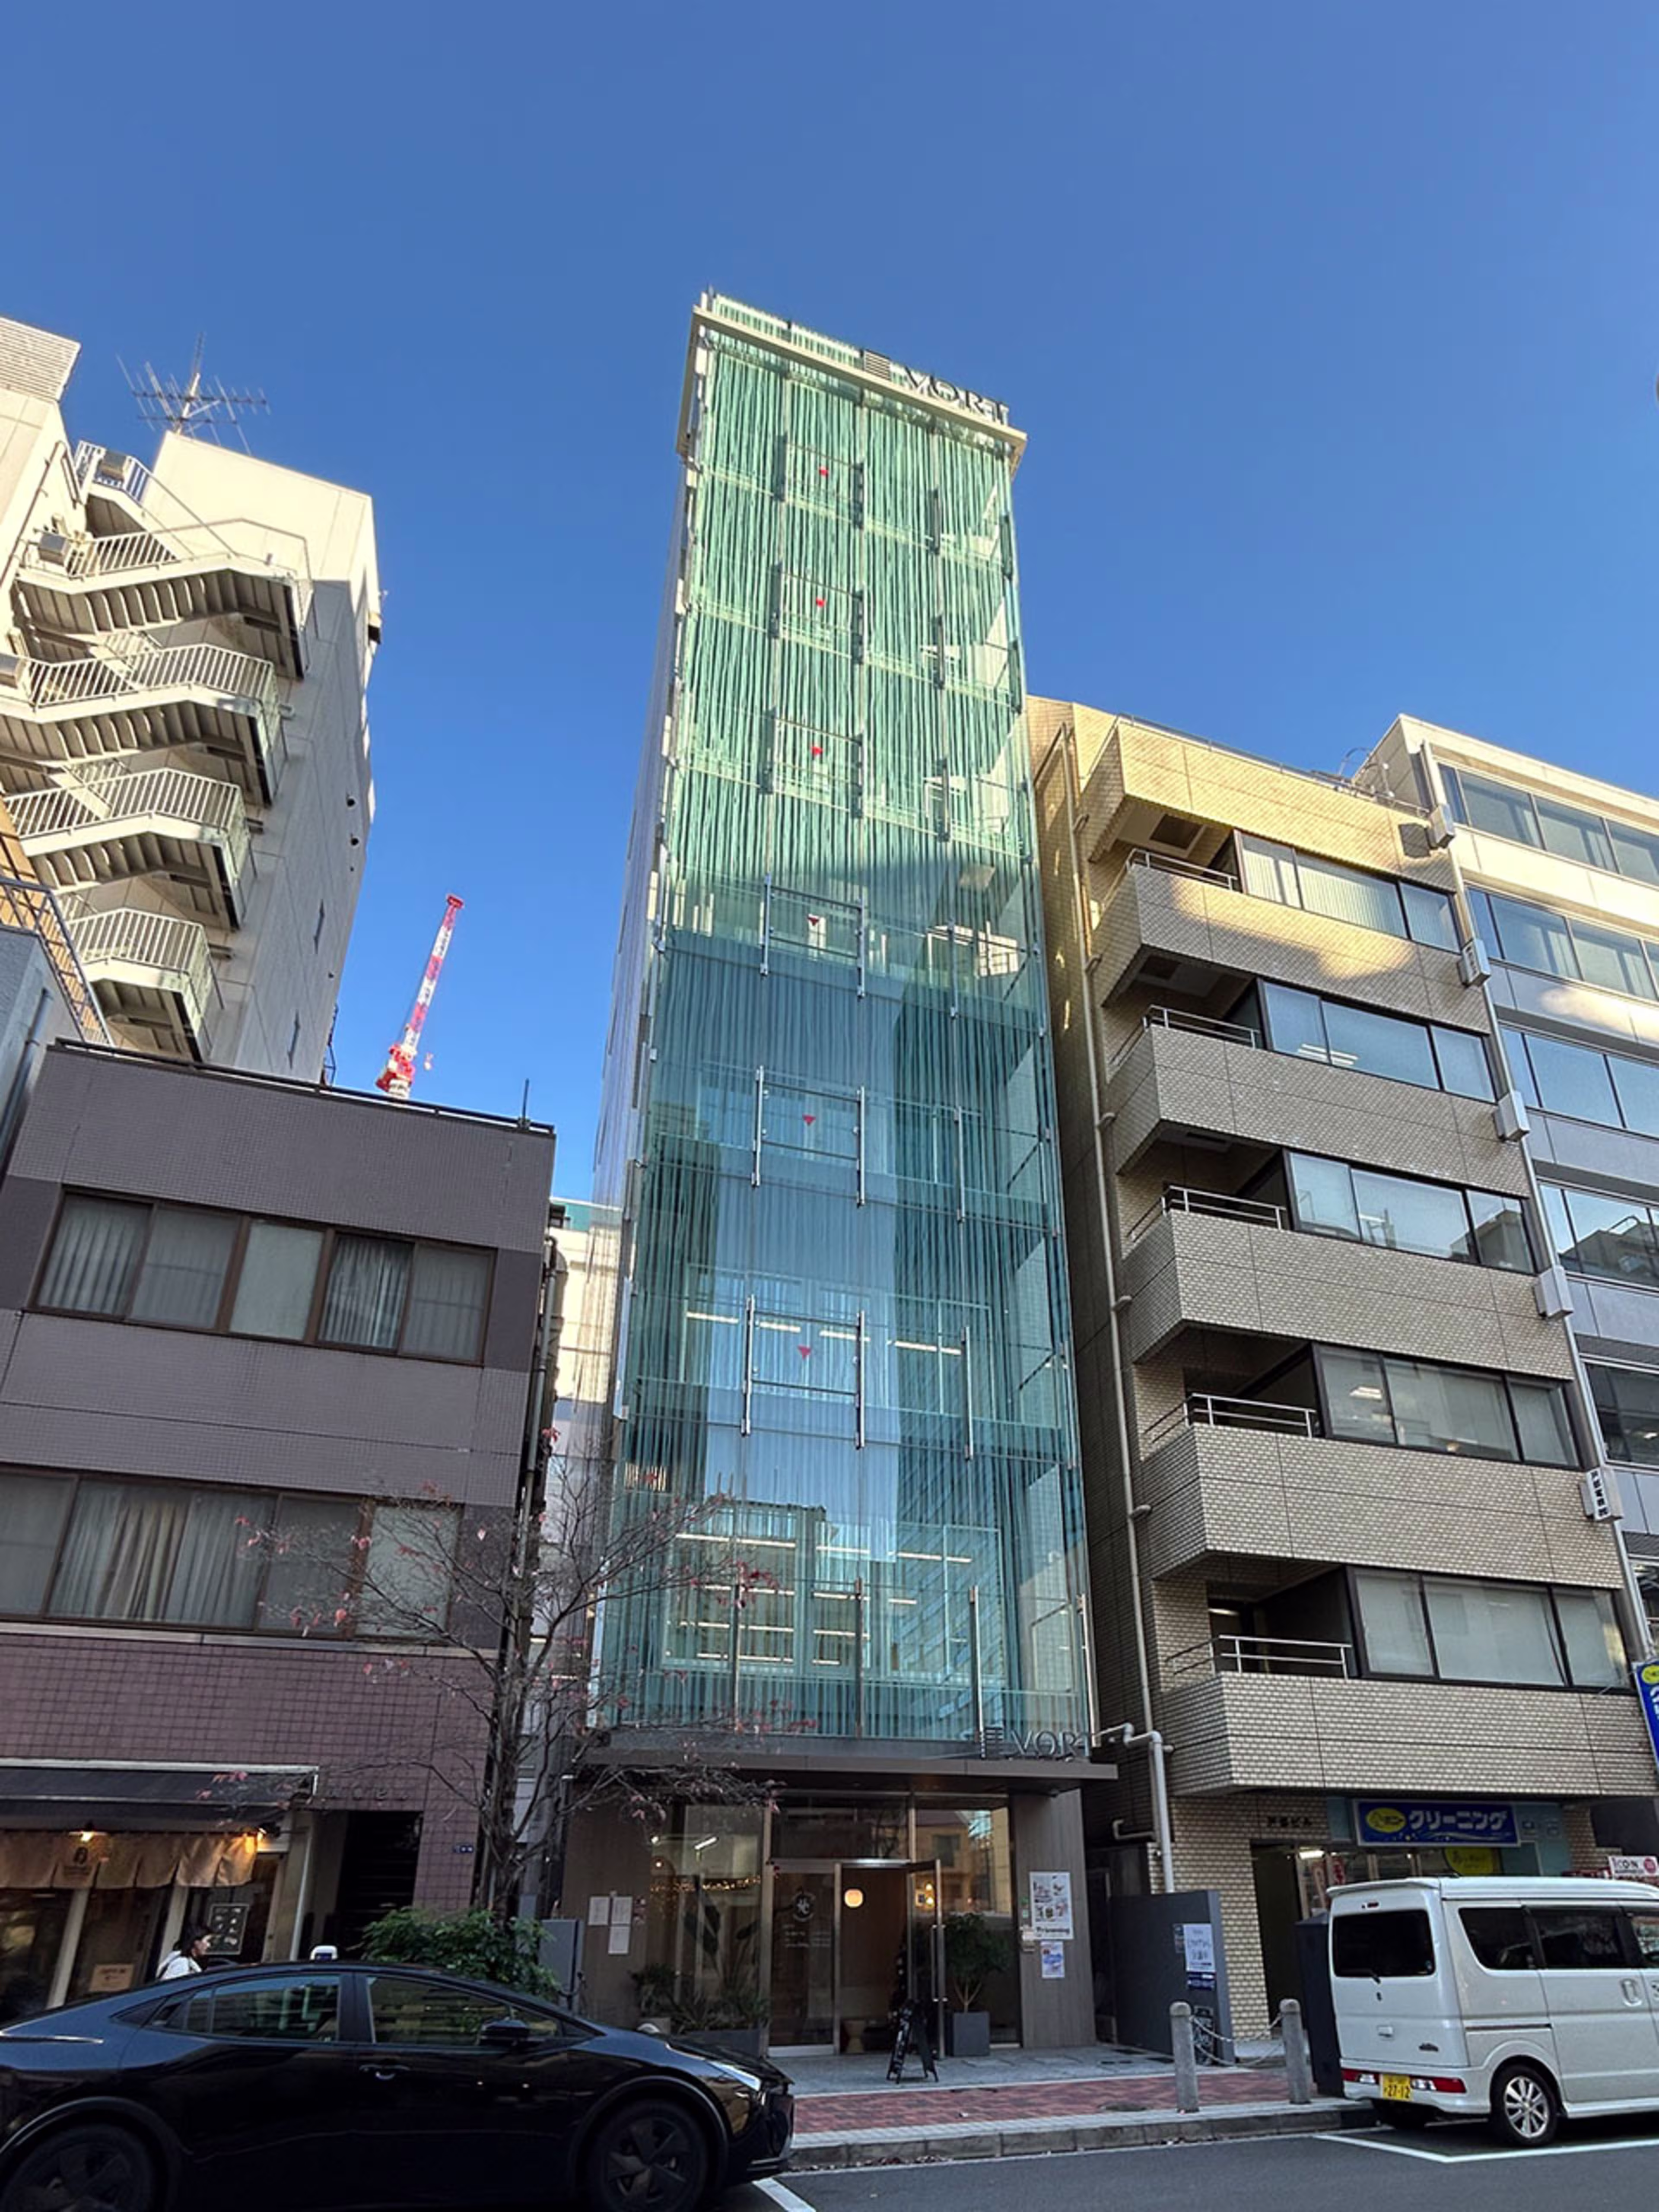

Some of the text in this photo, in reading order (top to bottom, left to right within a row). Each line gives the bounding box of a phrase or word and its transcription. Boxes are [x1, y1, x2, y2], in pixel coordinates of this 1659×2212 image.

[1409, 1809, 1507, 1830] クリーニング
